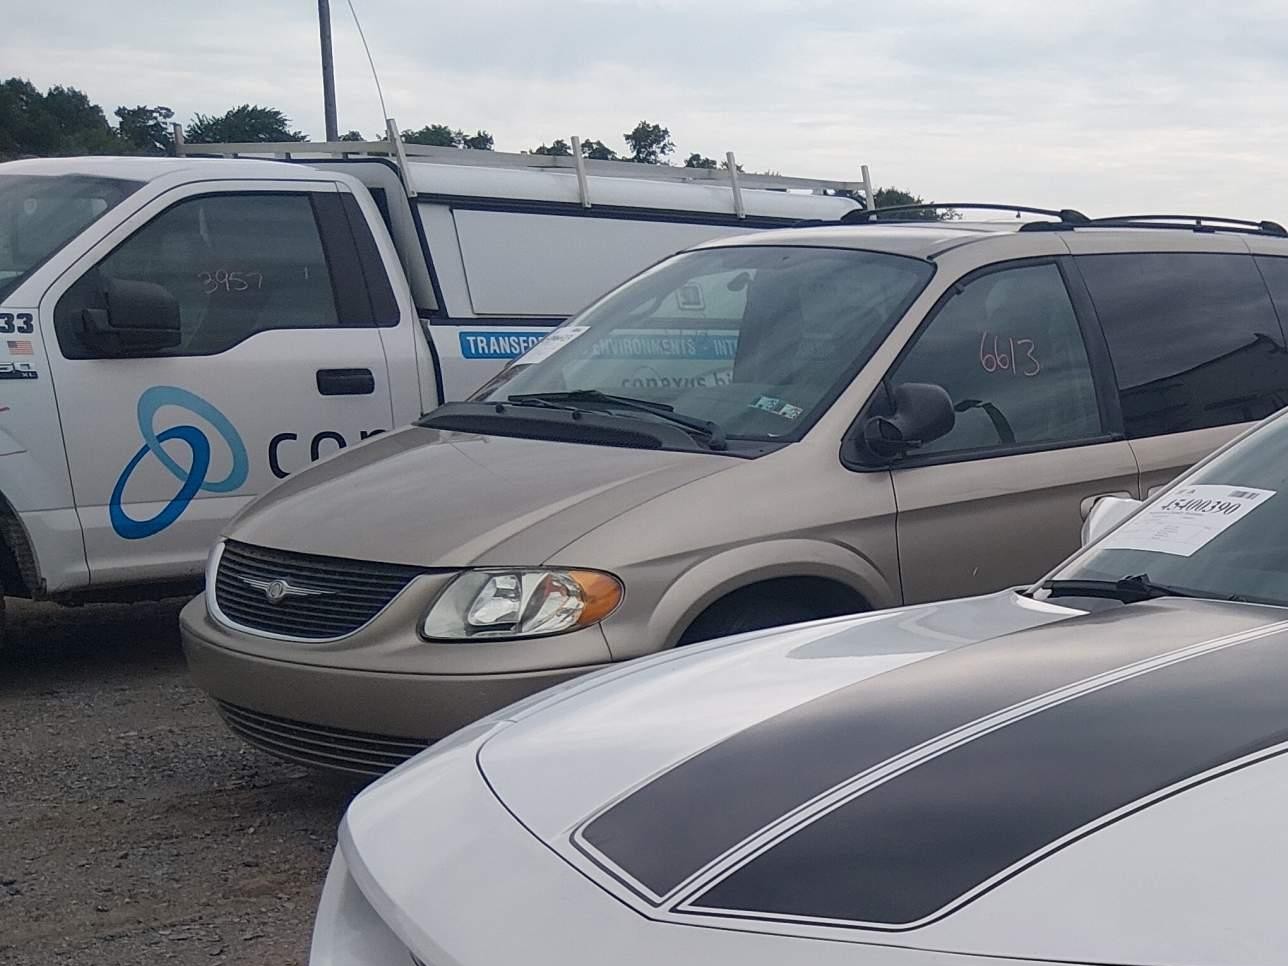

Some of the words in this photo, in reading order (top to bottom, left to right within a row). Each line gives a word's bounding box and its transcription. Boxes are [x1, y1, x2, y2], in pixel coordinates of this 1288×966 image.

[198, 269, 263, 294] 3957
[466, 336, 546, 355] TRANSFO
[980, 331, 1040, 376] 6613
[269, 429, 387, 479] co
